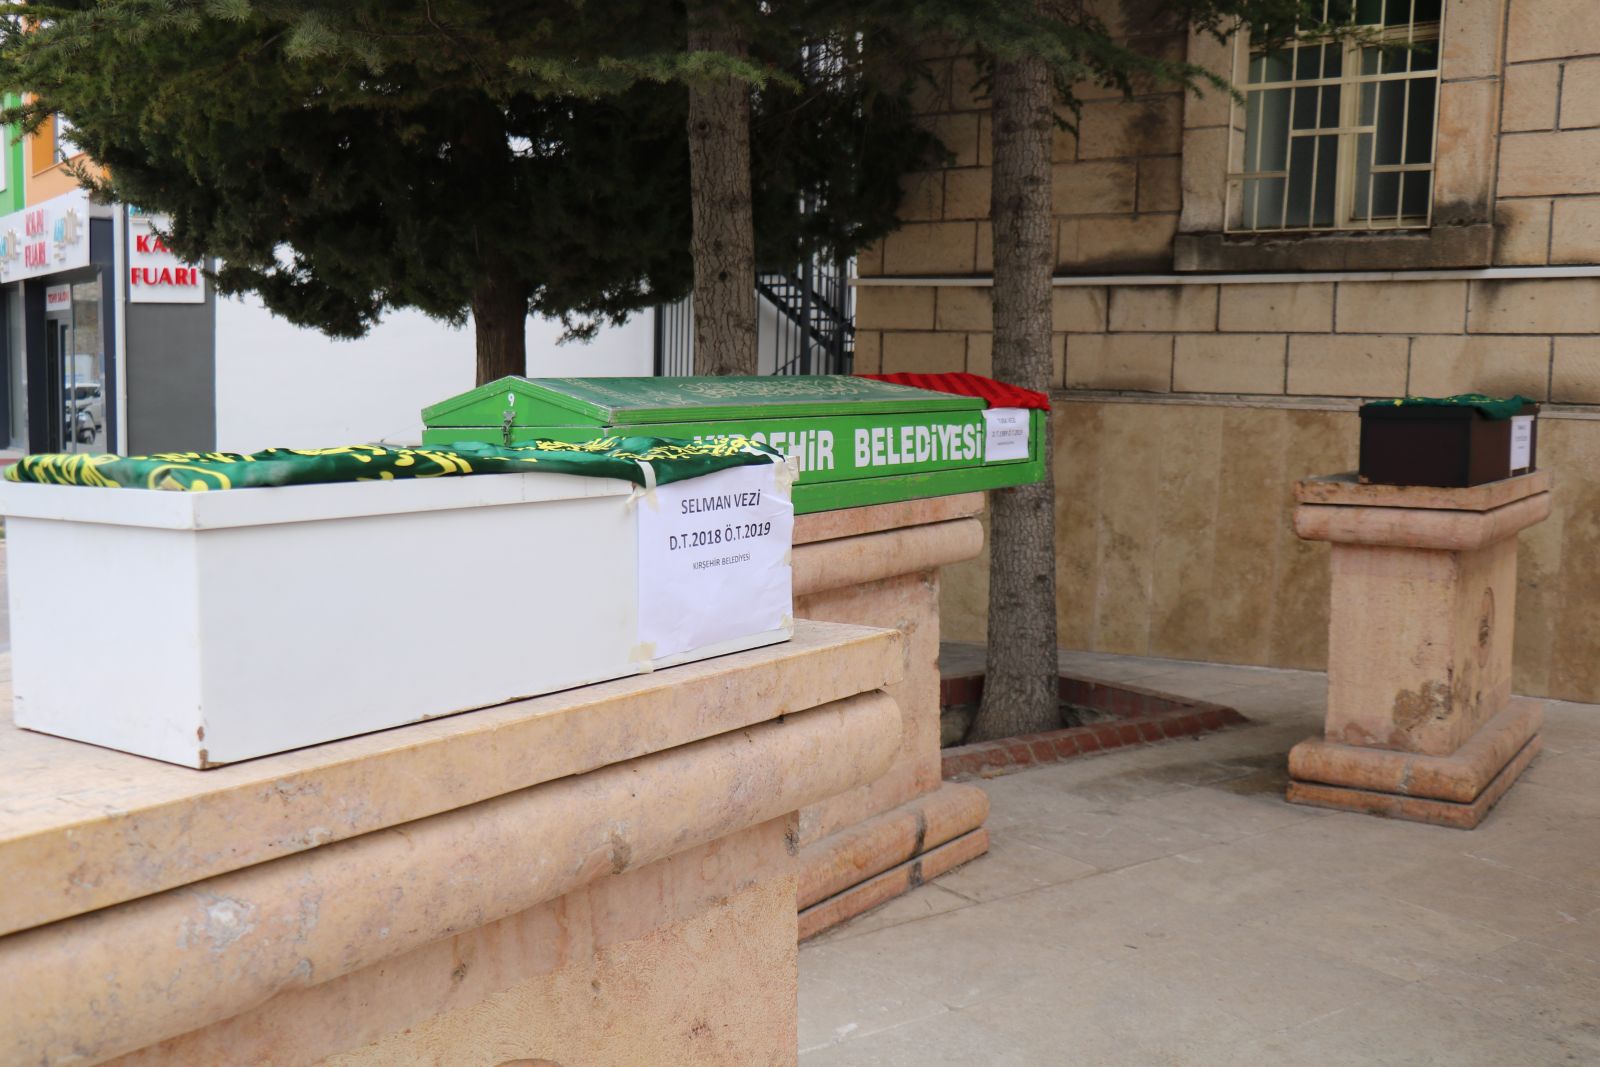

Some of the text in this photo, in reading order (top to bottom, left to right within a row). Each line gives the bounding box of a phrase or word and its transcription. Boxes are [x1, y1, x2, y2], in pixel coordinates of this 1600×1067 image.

[131, 267, 197, 285] FUARI
[508, 392, 515, 406] 9
[681, 489, 761, 514] SELMAN VEZİ
[669, 521, 771, 550] D.T.2018 Ö.T.2019
